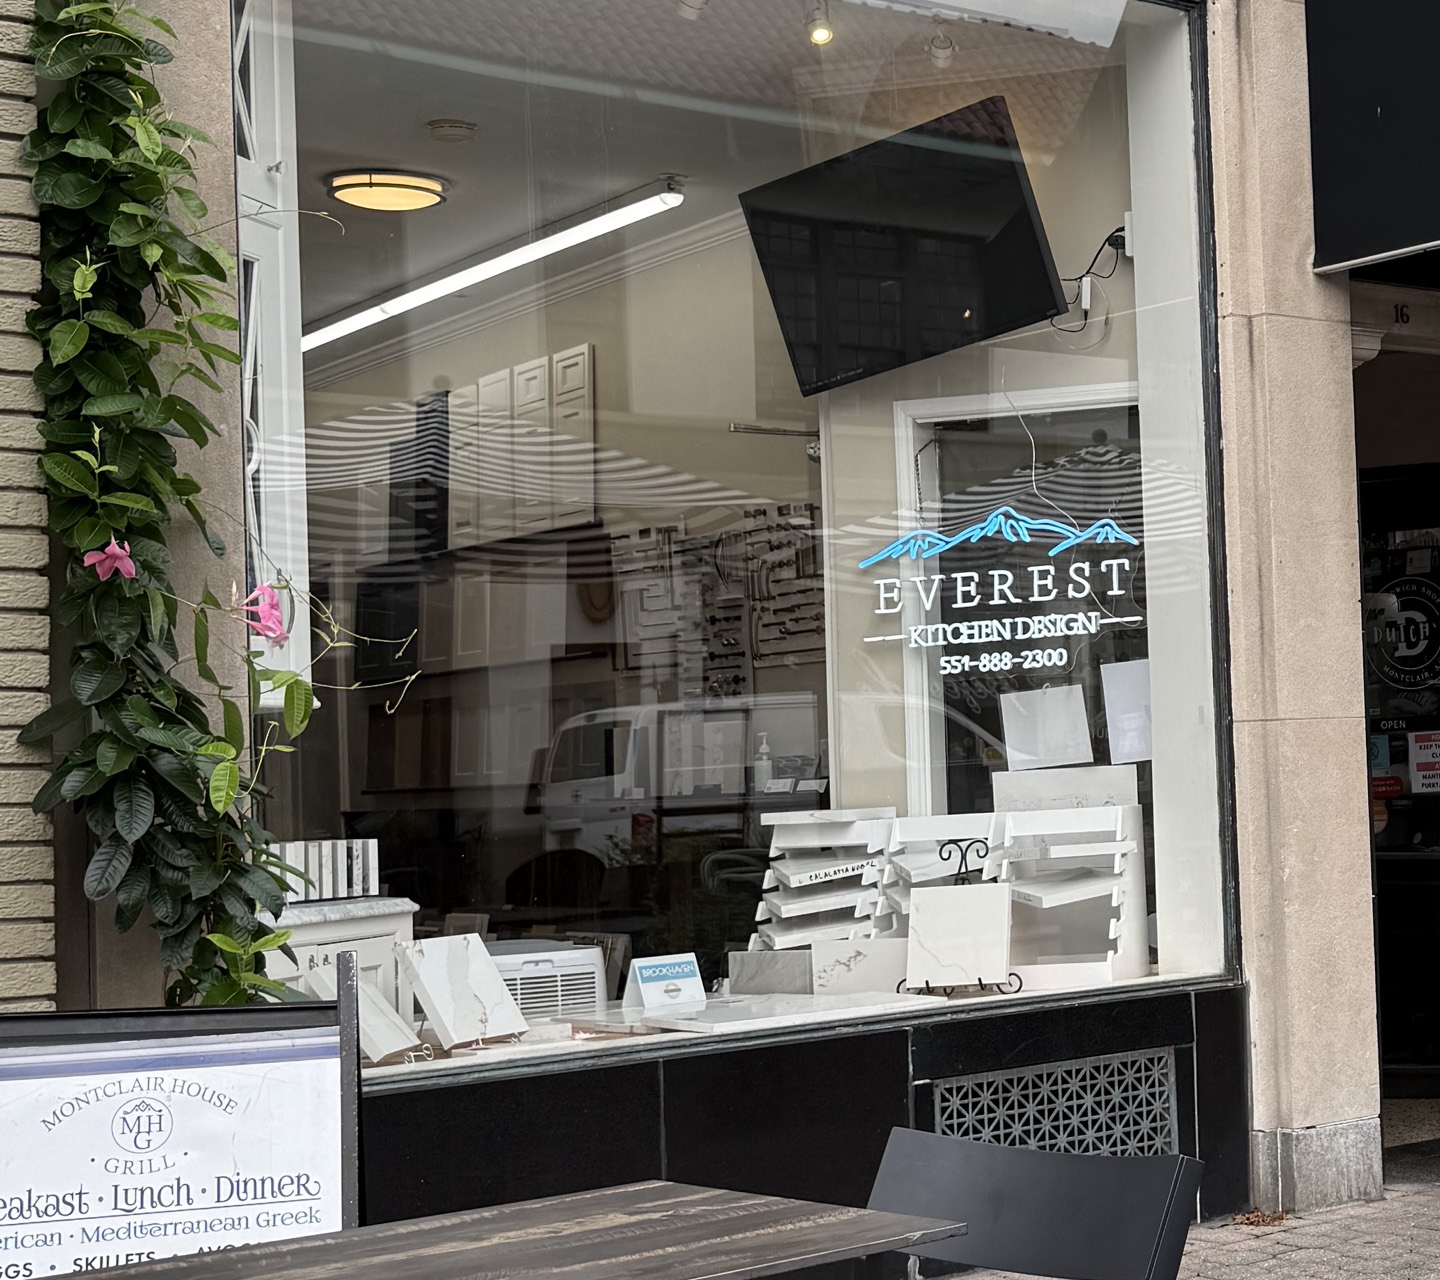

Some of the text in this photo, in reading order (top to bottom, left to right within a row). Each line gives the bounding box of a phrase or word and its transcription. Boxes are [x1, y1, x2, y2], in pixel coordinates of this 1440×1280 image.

[1393, 304, 1410, 324] 16
[873, 558, 1130, 614] EVEREST
[908, 611, 1101, 648] KITCHEN DESIGN
[939, 647, 1068, 675] 551-888-2300
[1380, 719, 1406, 730] OPEN
[40, 1076, 239, 1132] MONTCLAIR HOUSE
[104, 1154, 177, 1176] GRILL
[80, 1219, 250, 1245] Mediterranean
[256, 1206, 322, 1229] Greek
